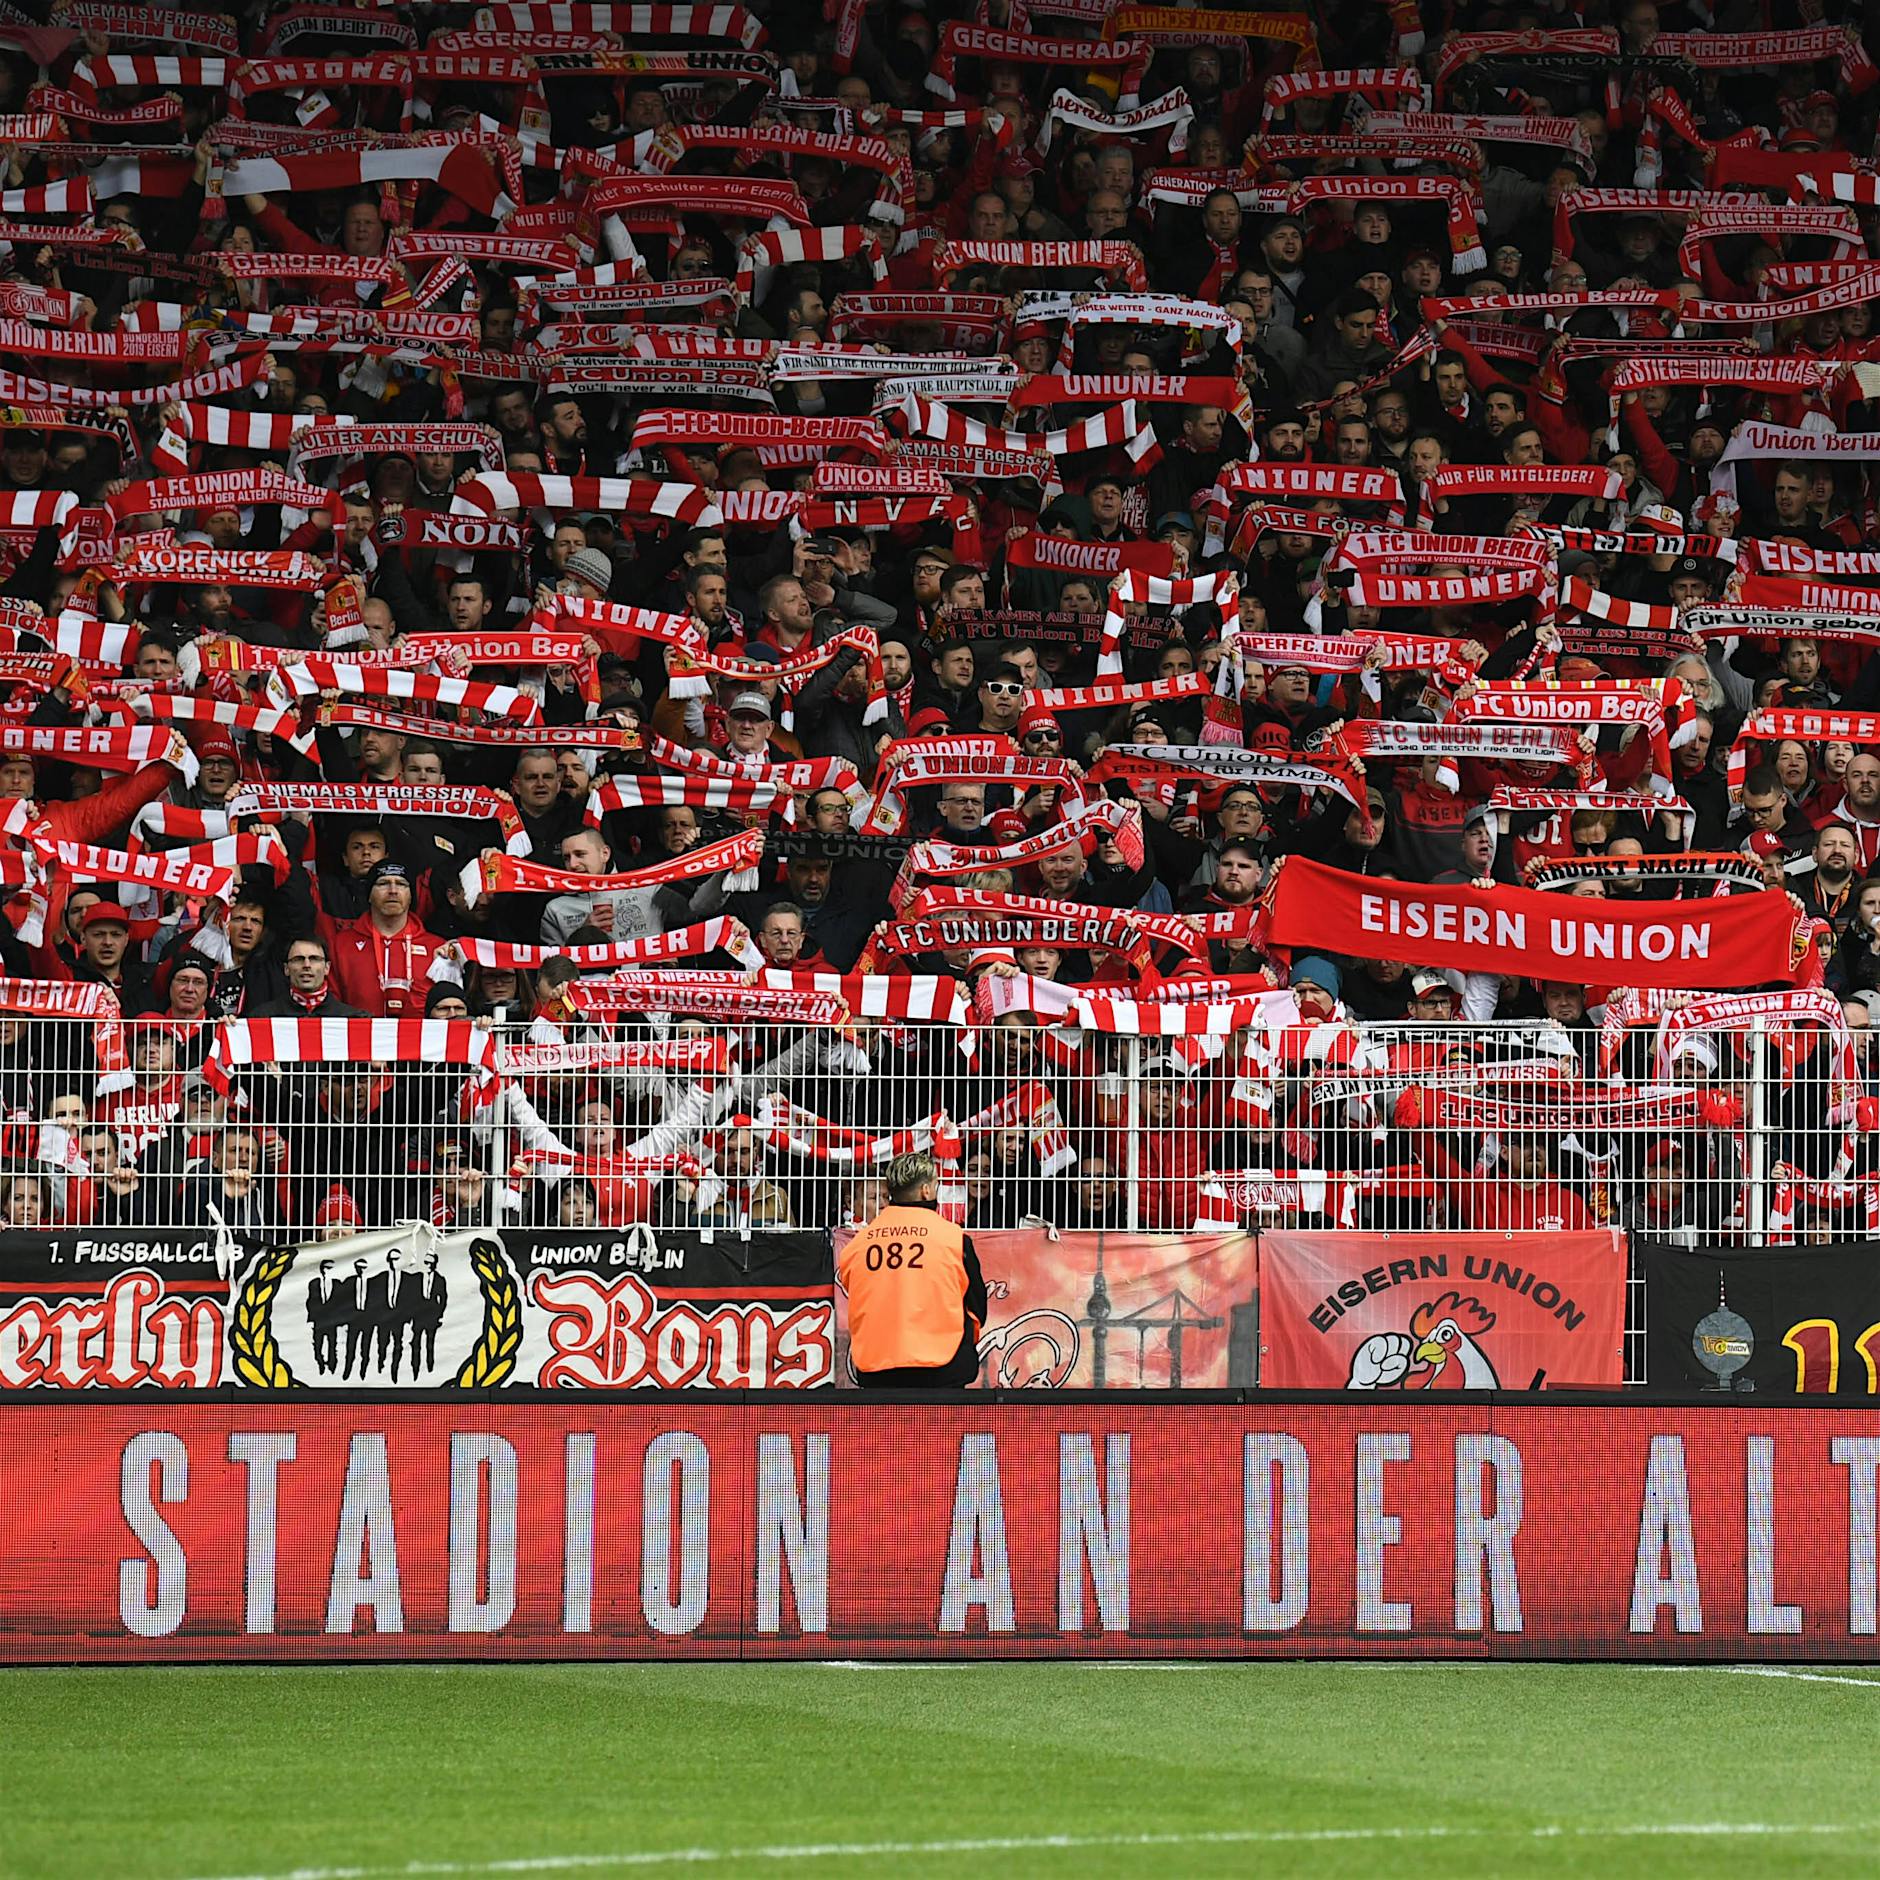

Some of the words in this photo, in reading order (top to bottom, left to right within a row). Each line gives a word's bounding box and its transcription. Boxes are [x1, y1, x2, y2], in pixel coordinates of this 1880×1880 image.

[73, 4, 148, 25] NIEMALS
[957, 27, 1144, 60] GEGENGERADE
[1654, 41, 1682, 57] DIE
[1686, 40, 1750, 56] MACHT
[1756, 38, 1780, 54] AN
[1786, 36, 1820, 54] DER
[646, 55, 687, 70] UNION
[1273, 68, 1420, 98] UNIONER
[71, 101, 124, 122] Union
[1404, 114, 1453, 131] UNION
[646, 180, 704, 197] Schulter
[1151, 177, 1217, 192] GENERATION
[1323, 178, 1407, 198] Union
[1562, 188, 1660, 212] EISERN
[515, 210, 543, 228] NUR
[549, 204, 575, 226] FÜR
[1701, 213, 1775, 228] UNION
[963, 242, 1024, 265] UNION
[1032, 242, 1101, 266] BERLIN
[577, 286, 651, 301] Union
[870, 296, 945, 313] UNION
[1474, 295, 1505, 310] FC
[1507, 292, 1579, 307] Union
[1587, 288, 1660, 305] Berlin
[1109, 304, 1145, 315] WEITER
[1155, 306, 1184, 317] GANZ
[1186, 309, 1215, 321] NACH
[1698, 301, 1728, 320] FC
[1735, 300, 1810, 319] Union
[390, 313, 472, 341] UNION
[51, 328, 117, 356] BERLIN
[122, 332, 179, 345] BUNDESLIGA
[122, 342, 144, 358] 2019
[146, 343, 178, 360] EISERN
[0, 370, 120, 407] EISERN
[131, 363, 243, 406] UNION
[564, 367, 604, 382] FC
[613, 367, 691, 382] Union
[1702, 362, 1805, 386] BUNDESLIGA
[613, 384, 654, 394] never
[662, 383, 698, 394] walk
[704, 384, 751, 397] alone!
[909, 381, 934, 398] EURE
[1064, 373, 1186, 399] UNIONER
[25, 409, 62, 425] UNION
[371, 426, 406, 444] AN
[1747, 429, 1816, 451] Union
[147, 480, 161, 501] 1.
[167, 478, 190, 498] FC
[195, 473, 255, 494] UNION
[819, 468, 888, 487] UNION
[1233, 470, 1386, 498] UNIONER
[1436, 470, 1463, 488] NUR
[1468, 466, 1496, 486] FÜR
[1499, 467, 1596, 485] MITGLIEDER!
[149, 494, 193, 509] STADION
[197, 492, 212, 506] AN
[214, 491, 235, 505] DER
[238, 489, 268, 504] ALTEN
[1252, 508, 1307, 530] ALTE
[1034, 539, 1121, 571] UNIONER
[1383, 535, 1409, 553] FC
[1412, 537, 1477, 554] UNION
[137, 544, 271, 571] KÖPENICK
[1379, 570, 1538, 601] UNIONER
[329, 611, 361, 630] Berlin
[946, 609, 979, 625] WIR
[983, 610, 1042, 625] KAMEN
[1048, 611, 1075, 625] AUS
[1685, 608, 1724, 631] Für
[1731, 609, 1805, 627] Union
[967, 625, 999, 642] FC
[1004, 627, 1075, 643] Union
[1747, 626, 1777, 636] Alte
[315, 649, 393, 666] UNION
[1473, 694, 1505, 716] FC
[1513, 695, 1591, 719] Union
[2, 729, 113, 754] ONER
[490, 729, 608, 744] UNION!
[1376, 724, 1407, 741] FC
[1418, 727, 1485, 744] UNION
[1492, 729, 1575, 750] BERLIN
[1119, 745, 1169, 762] FC
[1178, 746, 1273, 765] Union
[915, 757, 1004, 776] UNION
[1213, 762, 1243, 777] für
[267, 784, 356, 798] NIEMALS
[386, 798, 501, 817] UNION
[58, 840, 213, 891] NIONER
[1637, 858, 1707, 876] NACH
[513, 867, 536, 888] 1.
[545, 873, 583, 892] FC
[925, 891, 947, 907] 1.
[955, 886, 994, 906] FC
[1003, 892, 1101, 918] Union
[897, 922, 935, 950] FC
[942, 919, 1034, 945] UNION
[1042, 918, 1144, 952] BERLIN
[1361, 892, 1527, 950] EISERN
[1550, 917, 1711, 962] UNION
[660, 971, 731, 985] NIEMALS
[16, 978, 104, 1015] BERLIN
[579, 986, 602, 1005] 1.
[607, 987, 643, 1005] FC
[651, 988, 736, 1010] UNION
[740, 994, 838, 1020] BERLIN
[1675, 1006, 1705, 1027] FC
[1708, 993, 1785, 1020] UNION
[112, 1101, 181, 1124] BERLIN
[866, 1224, 929, 1241] STEWARD
[48, 1242, 65, 1264] 1.
[530, 1243, 601, 1265] UNION
[865, 1243, 925, 1273] 082
[1307, 1254, 1448, 1335] EISERN
[1462, 1255, 1586, 1333] UNION
[533, 1269, 836, 1389] Boys
[118, 1430, 831, 1638] STADION
[937, 1431, 1132, 1634] AN
[1242, 1431, 1524, 1634] DER
[1628, 1433, 1880, 1636] ALT
